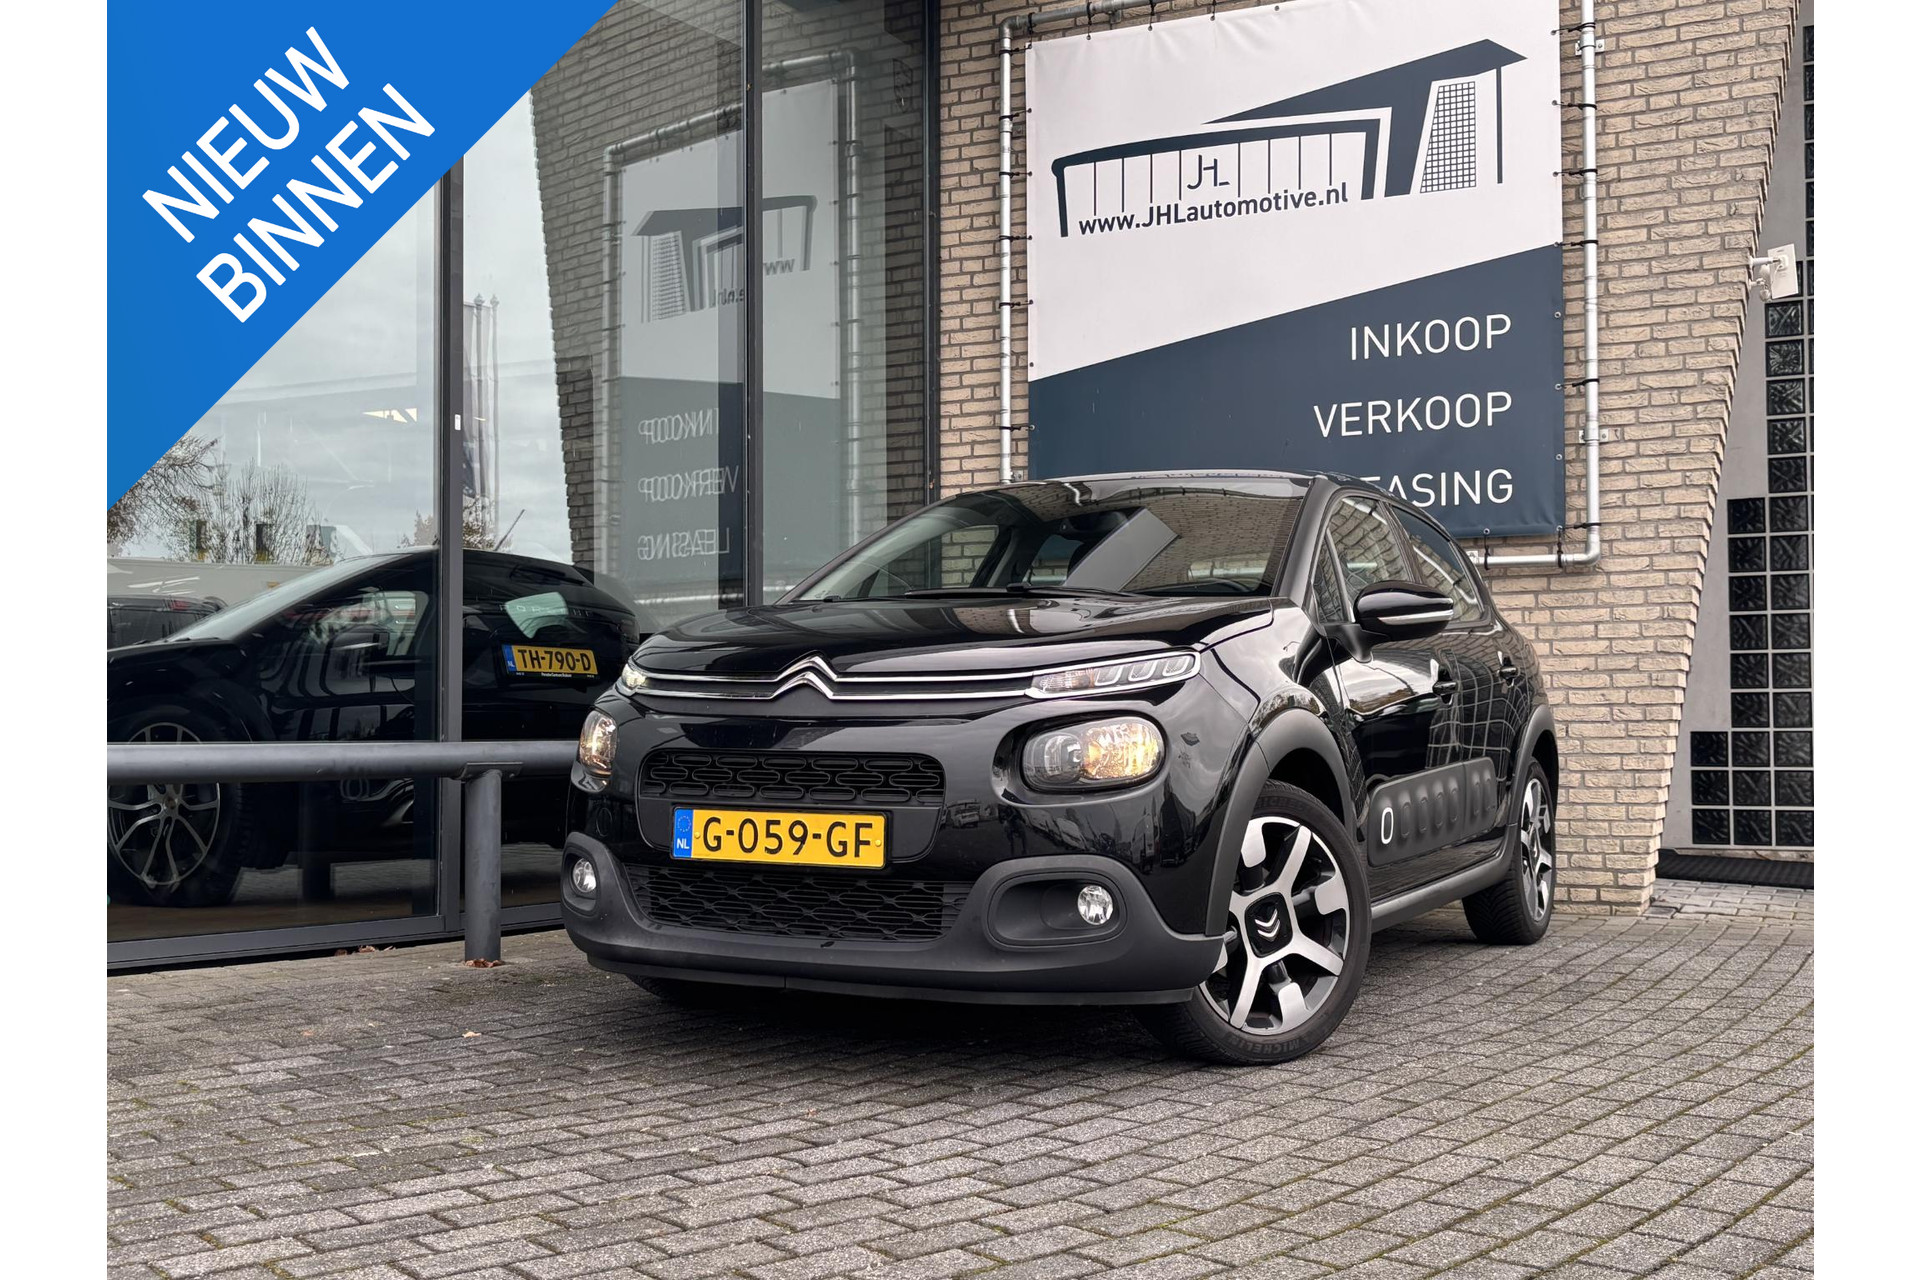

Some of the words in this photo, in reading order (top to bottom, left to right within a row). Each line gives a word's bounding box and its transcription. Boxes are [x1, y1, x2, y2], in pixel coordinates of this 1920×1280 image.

[1079, 182, 1348, 235] www.JHLautomotive.nl
[1350, 313, 1512, 361] INKOOP
[1313, 391, 1513, 438] VERKOOP
[1360, 468, 1513, 508] ASING
[518, 649, 591, 671] TH-790-D
[676, 837, 690, 850] NL
[703, 816, 873, 858] G-059-GF
